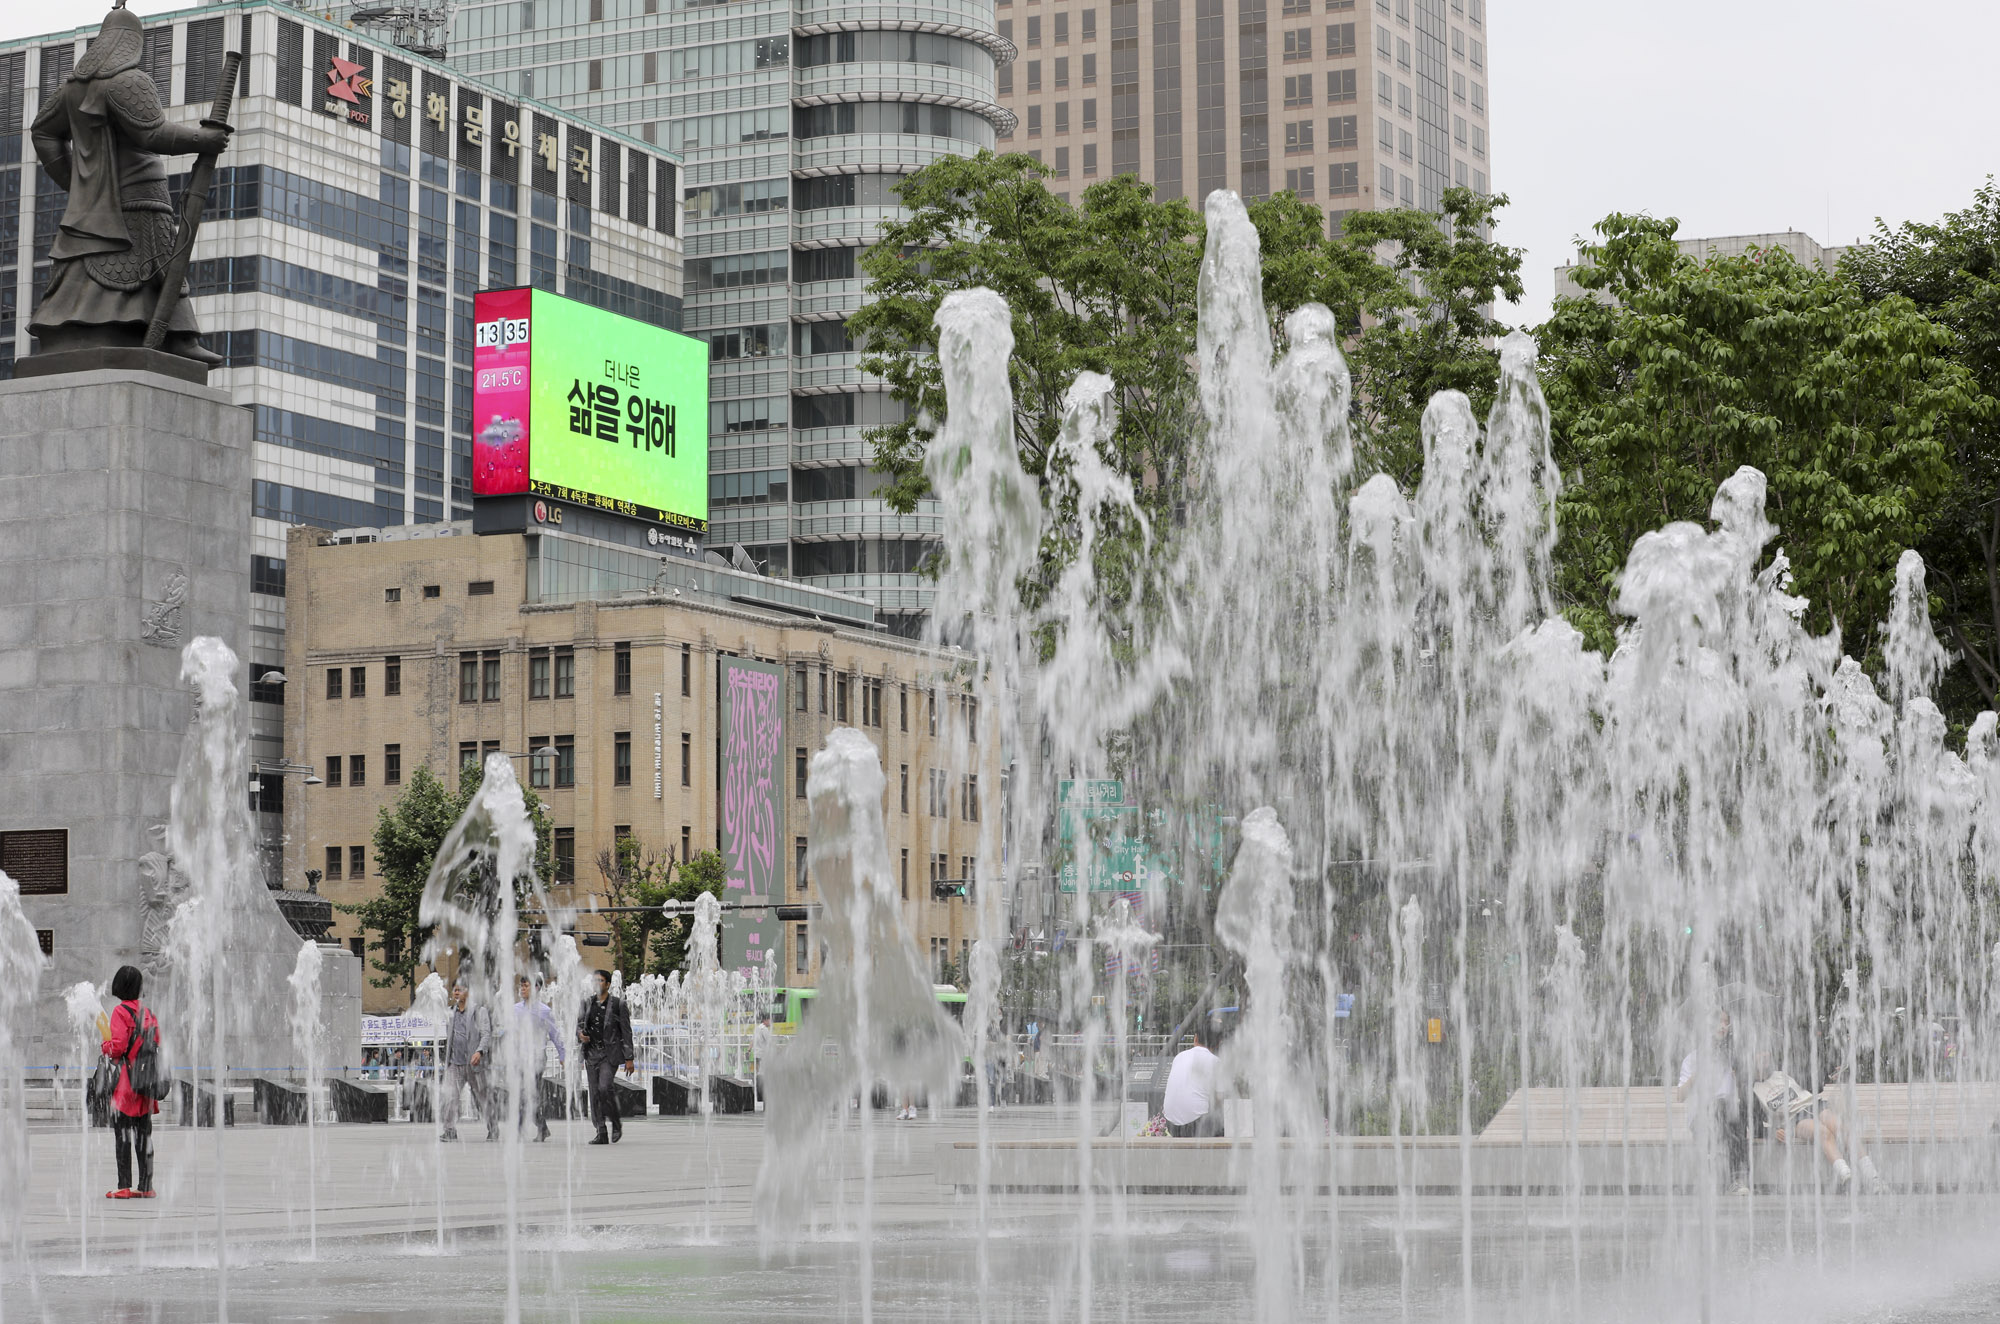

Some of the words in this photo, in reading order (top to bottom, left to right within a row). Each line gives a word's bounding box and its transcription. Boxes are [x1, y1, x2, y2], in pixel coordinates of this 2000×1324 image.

[350, 109, 369, 123] POST
[387, 77, 591, 183] 광화문우체국
[567, 378, 621, 443] 삶을
[626, 395, 676, 458] 위해
[548, 505, 562, 524] LG
[654, 709, 662, 720] of
